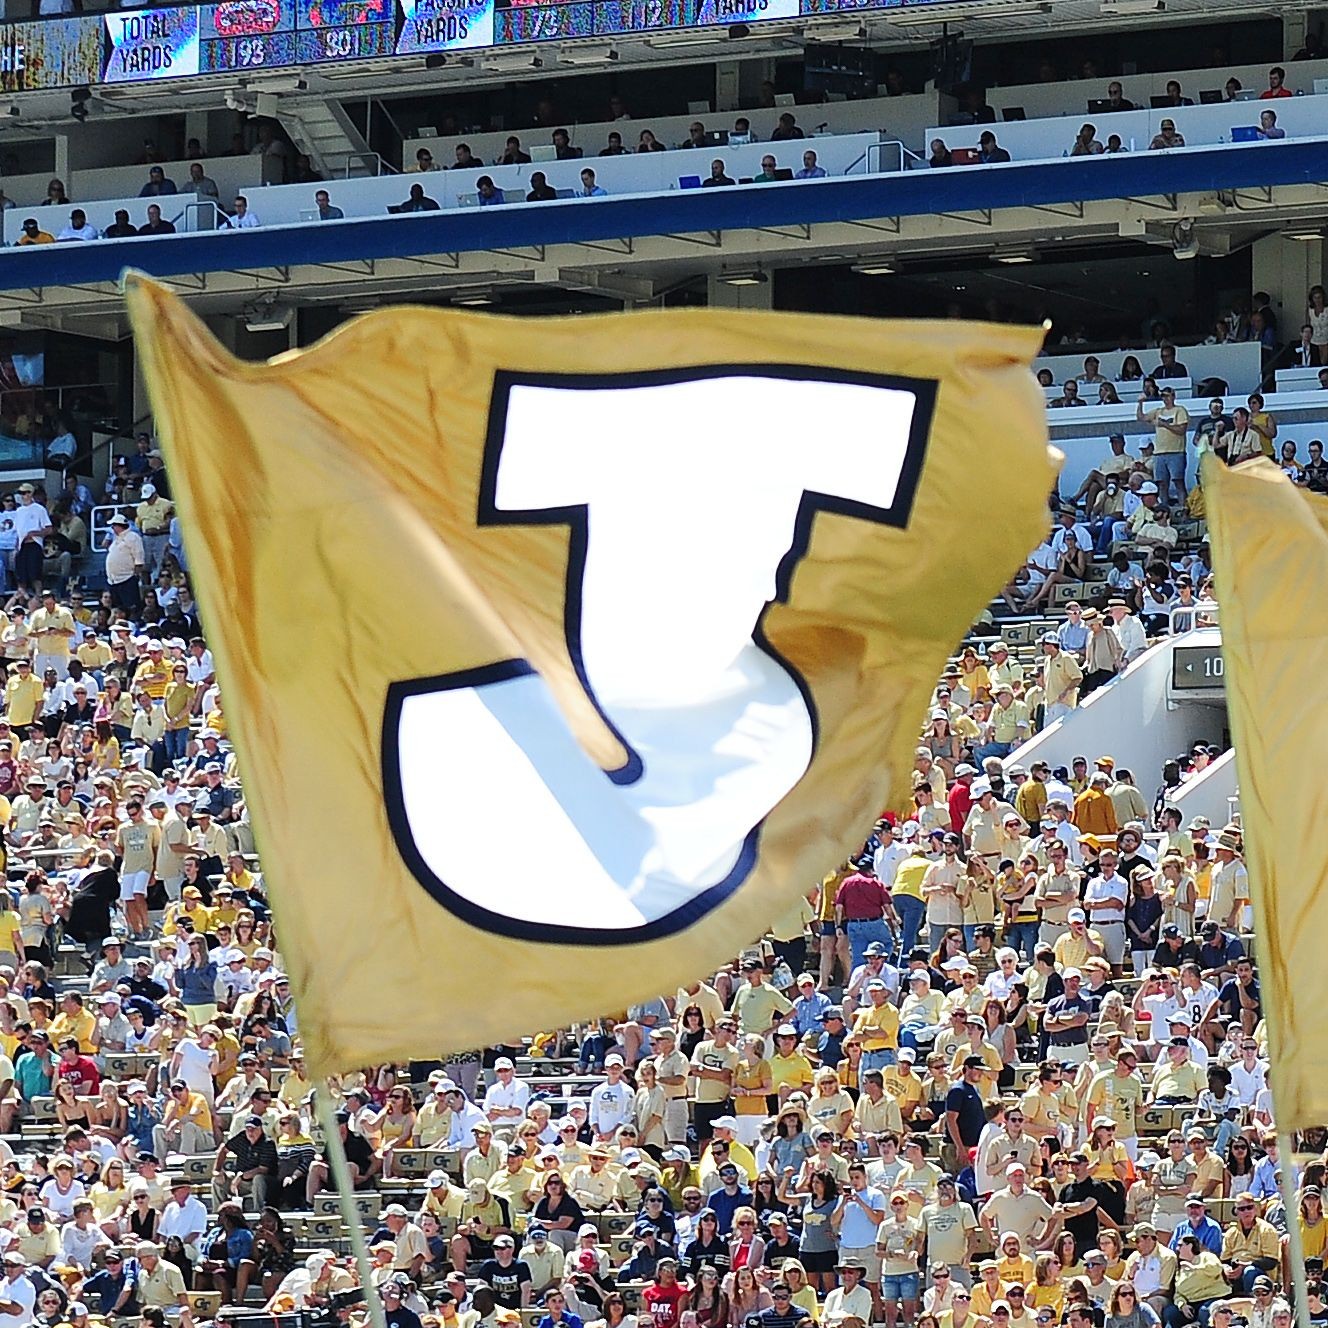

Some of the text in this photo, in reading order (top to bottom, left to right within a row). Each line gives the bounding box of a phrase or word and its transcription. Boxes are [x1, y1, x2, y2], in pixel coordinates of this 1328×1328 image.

[121, 14, 170, 42] TOTAL
[414, 15, 469, 44] YARDS
[121, 45, 173, 73] YARDS
[382, 364, 935, 946] J
[1204, 657, 1224, 677] 10
